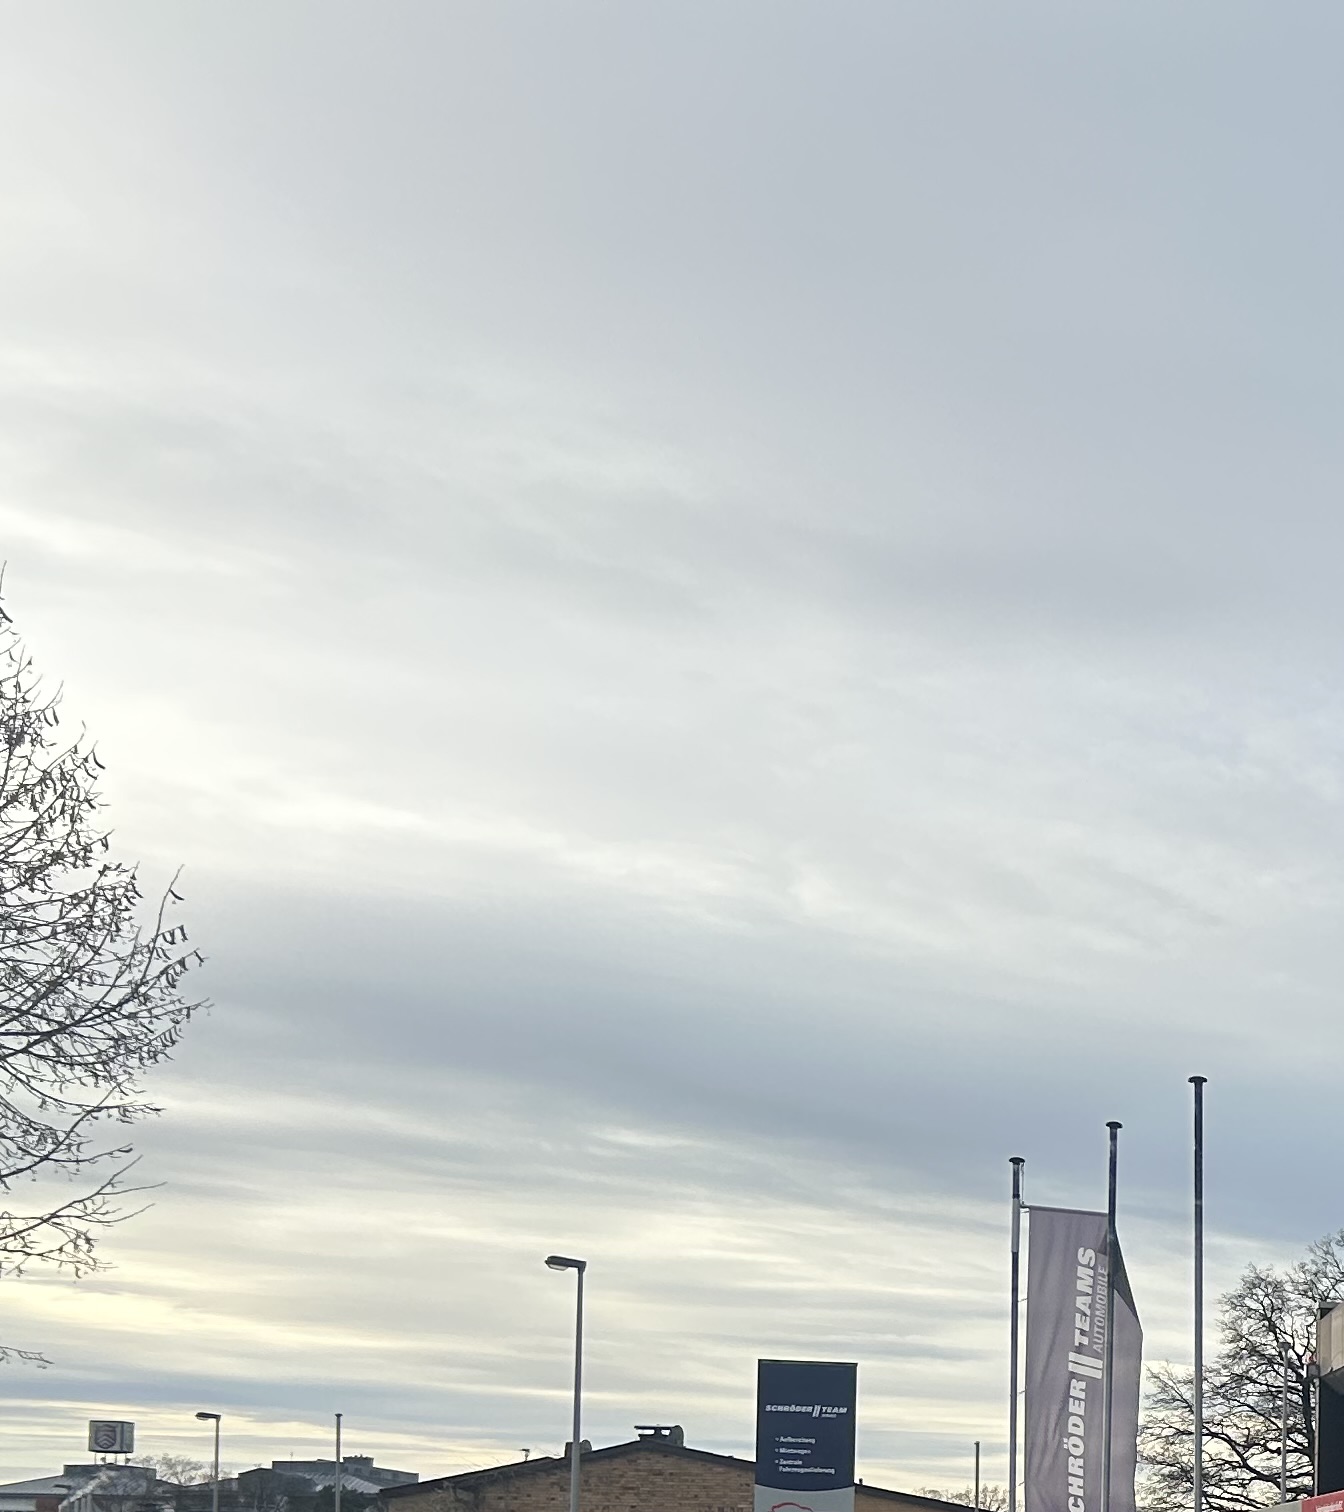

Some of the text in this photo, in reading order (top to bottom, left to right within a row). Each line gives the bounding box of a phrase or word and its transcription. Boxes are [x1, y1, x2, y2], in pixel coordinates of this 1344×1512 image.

[1074, 1246, 1096, 1347] TEAMS
[1092, 1265, 1108, 1353] AUTOMOBILE
[821, 1406, 848, 1414] TEAM
